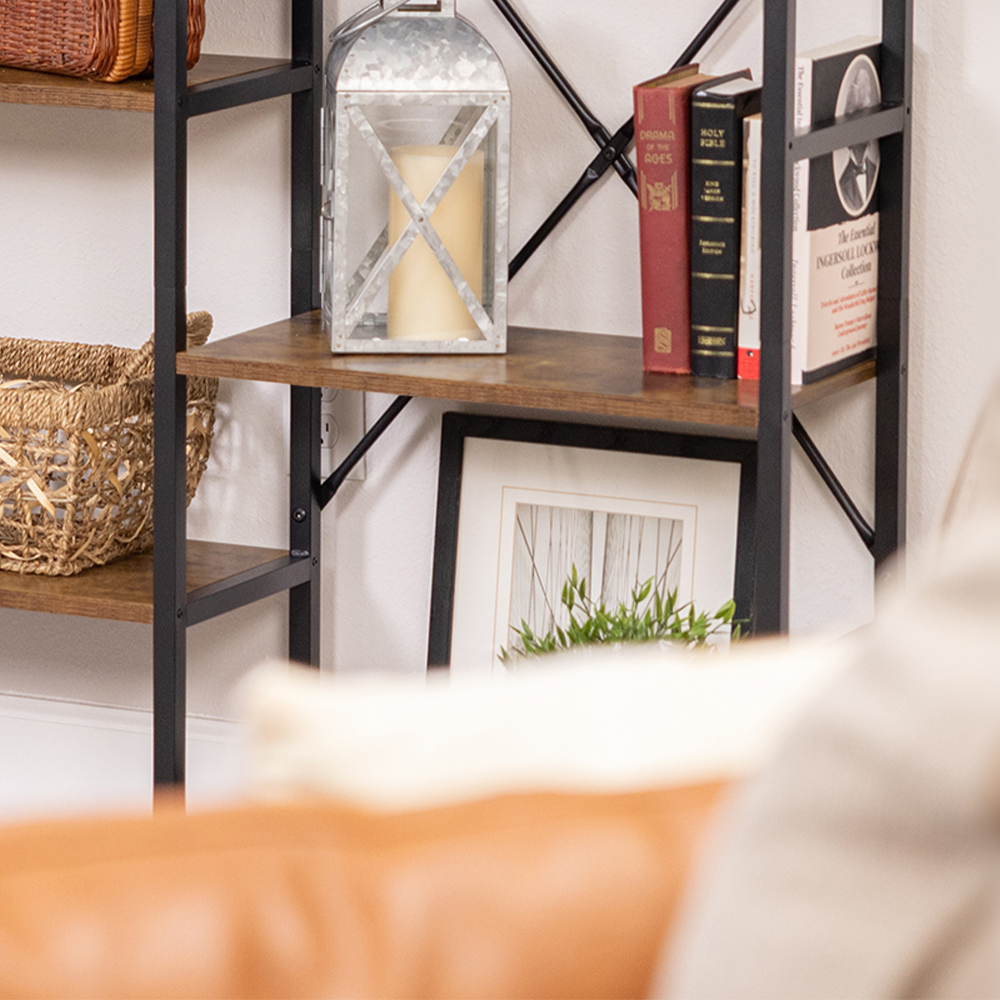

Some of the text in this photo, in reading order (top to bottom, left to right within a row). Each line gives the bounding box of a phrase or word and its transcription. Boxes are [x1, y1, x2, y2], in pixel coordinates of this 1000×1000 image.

[796, 81, 804, 116] Essential
[640, 130, 676, 140] DRAMA
[700, 128, 725, 138] HOLY
[646, 143, 670, 151] OF THE
[700, 139, 726, 148] BIBLE
[644, 153, 673, 165] AGES
[838, 221, 876, 245] The Essential
[816, 246, 856, 269] INGERSOLL
[841, 260, 872, 280] Collection
